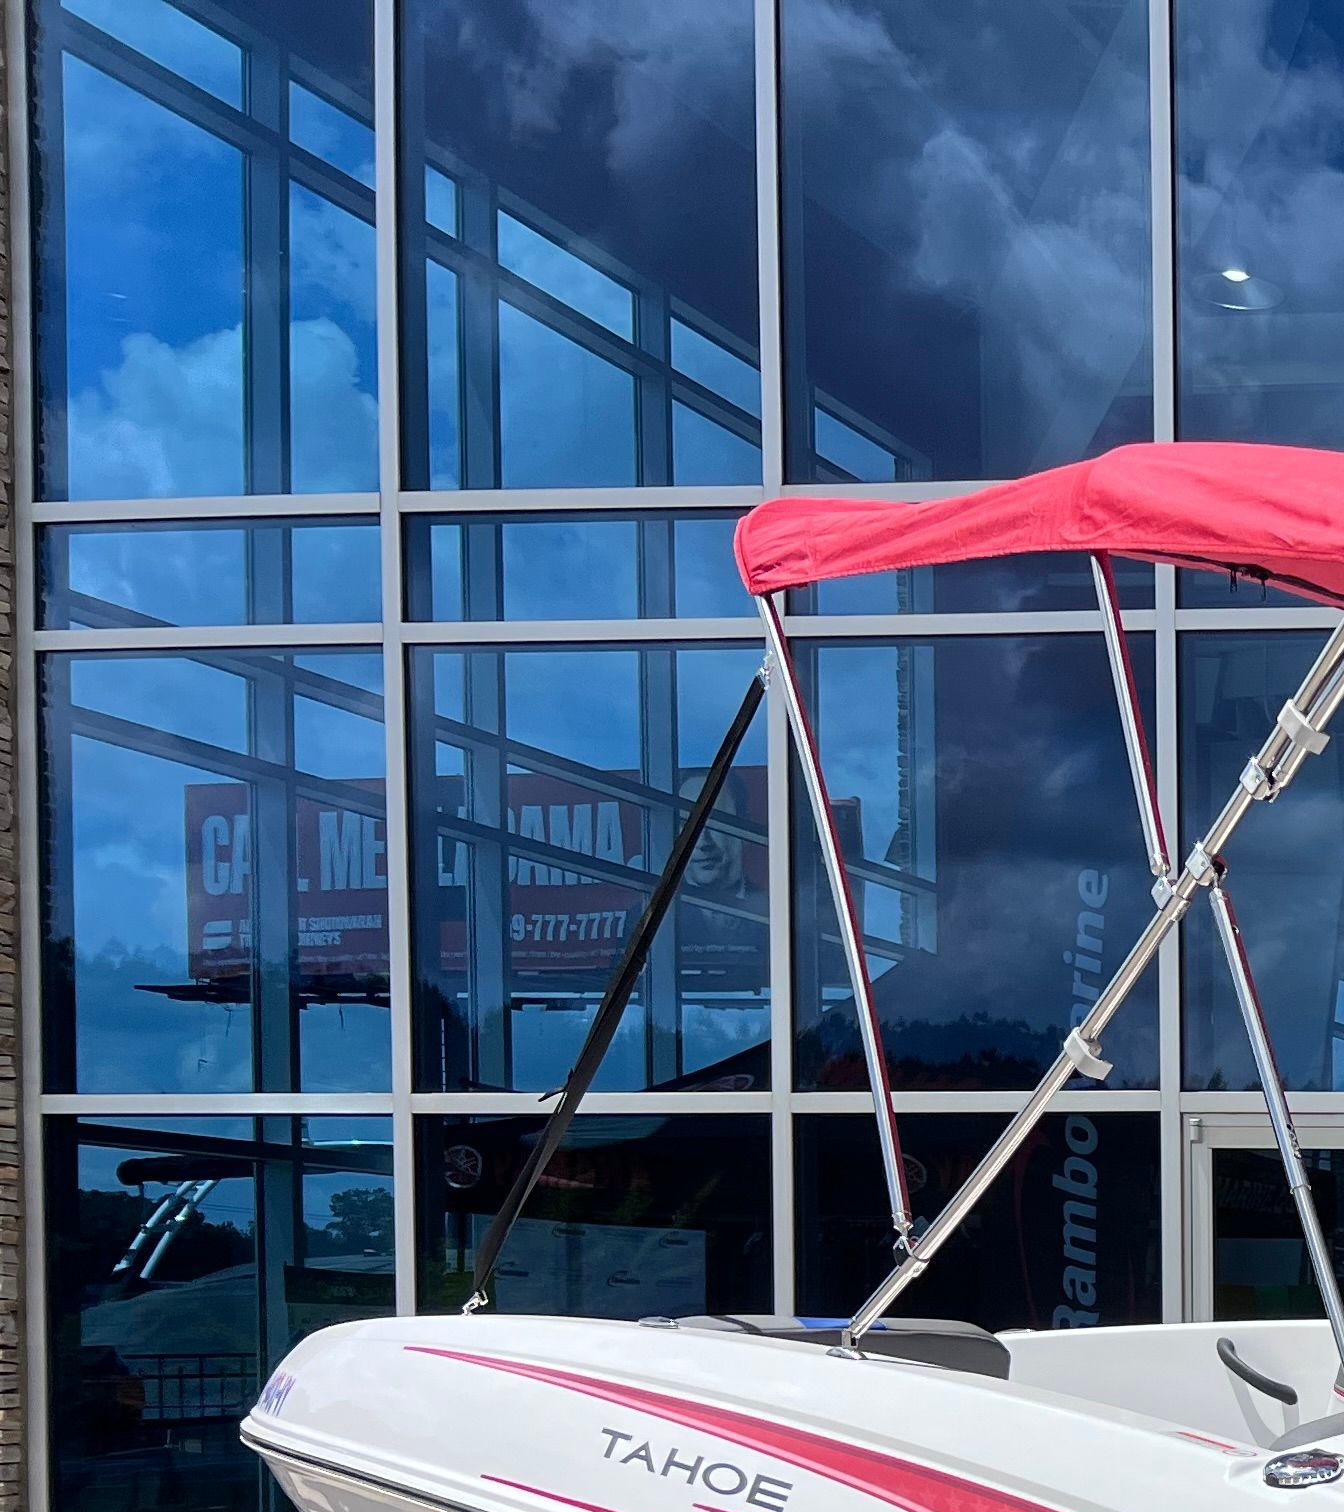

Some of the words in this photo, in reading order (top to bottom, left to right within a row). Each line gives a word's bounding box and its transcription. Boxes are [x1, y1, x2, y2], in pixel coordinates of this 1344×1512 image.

[202, 815, 309, 895] CA
[320, 811, 387, 890] ME
[510, 910, 627, 941] 9-777-7777
[601, 1428, 793, 1512] TAHOE
